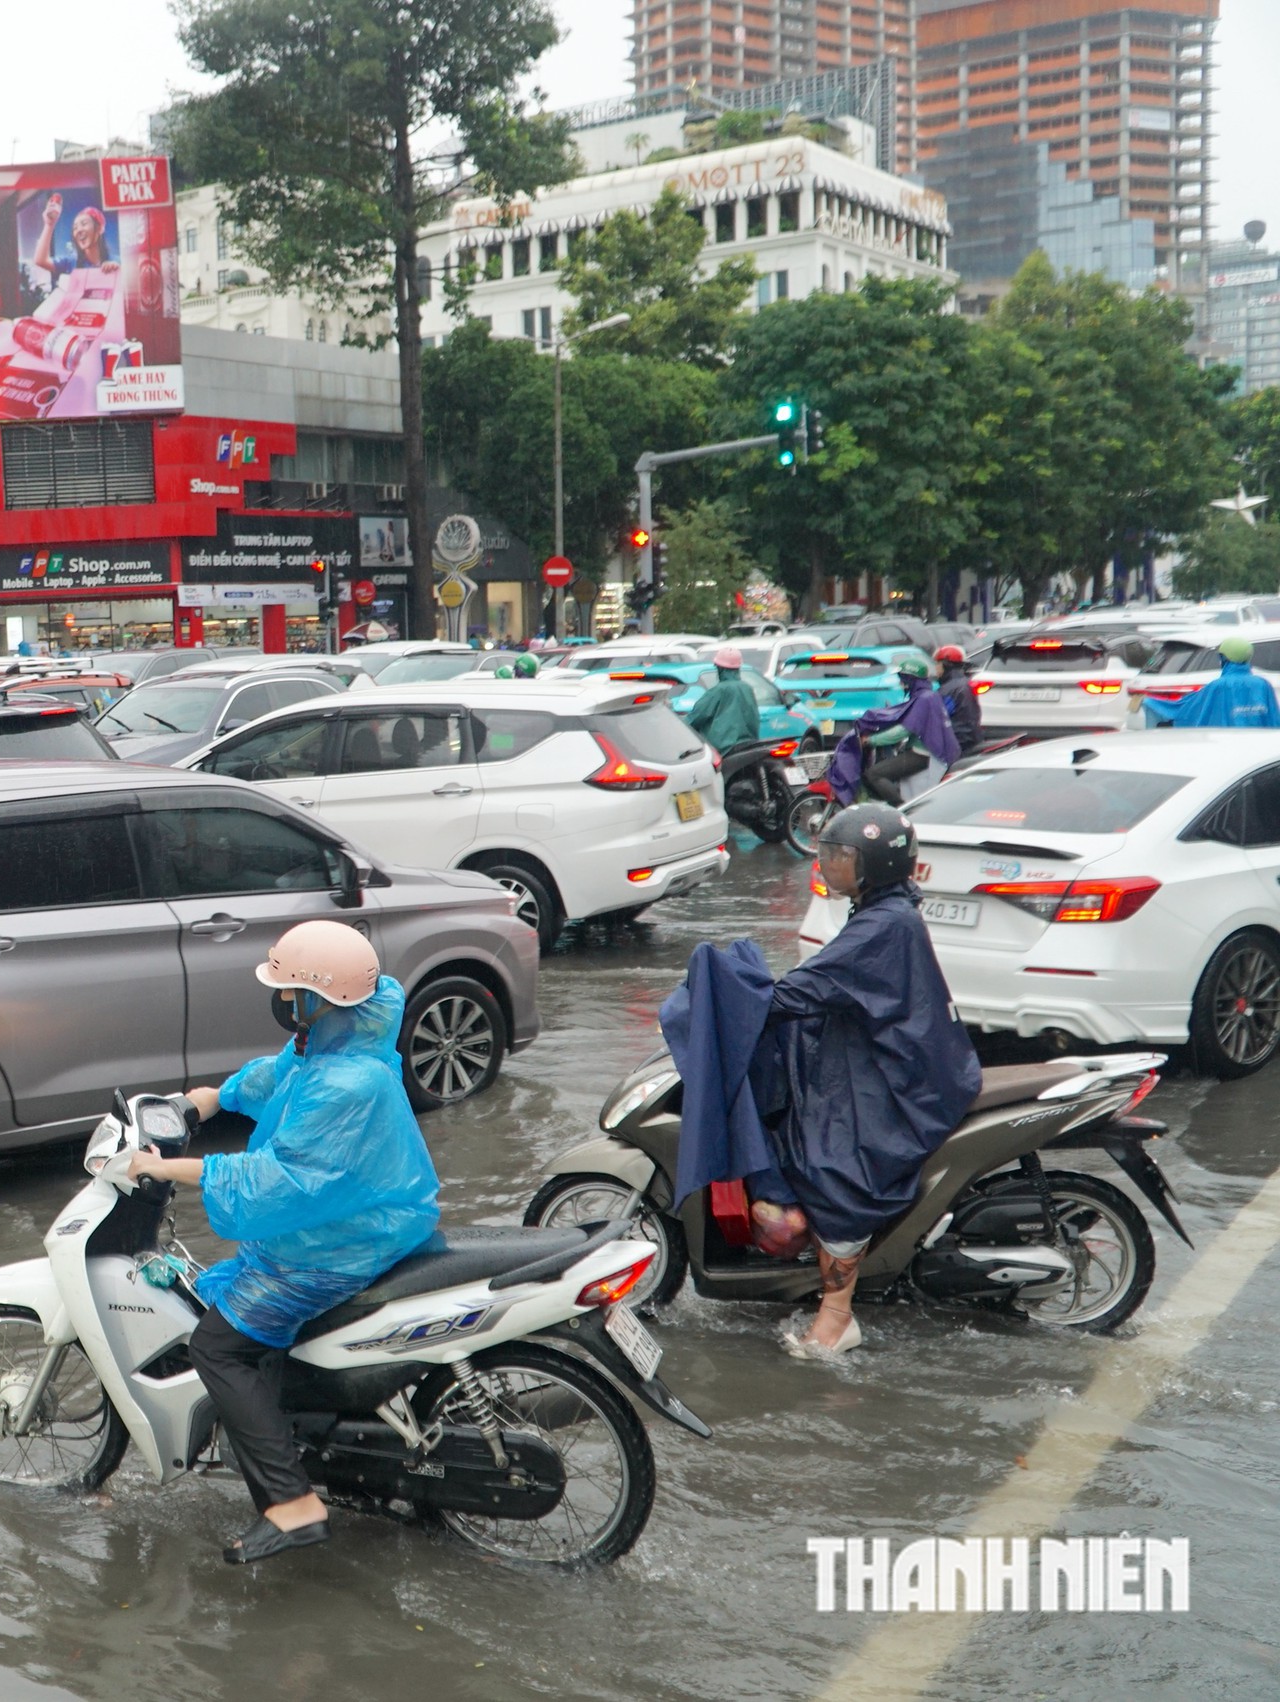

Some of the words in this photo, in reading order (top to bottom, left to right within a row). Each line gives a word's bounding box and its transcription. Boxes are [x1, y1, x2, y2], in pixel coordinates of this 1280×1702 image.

[111, 162, 156, 184] PARTY
[687, 158, 767, 191] MOTT
[775, 152, 805, 177] 23
[119, 181, 155, 202] PACK
[146, 371, 166, 385] HAY
[107, 390, 140, 404] TRONG
[234, 535, 262, 547] TRUNG
[263, 533, 281, 547] TÂM
[282, 535, 314, 547] LAPTOP
[69, 557, 151, 574] Shop.com.vn
[189, 549, 212, 566] ĐIỂM
[213, 551, 231, 566] ĐẾN
[232, 552, 257, 566] CÔNG
[258, 551, 281, 569] NGHỆ
[287, 554, 305, 566] CAM
[2, 577, 34, 589] Mobile
[43, 576, 73, 589] Laptop
[81, 574, 106, 587] Apple
[114, 571, 163, 585] Accessories
[1008, 1104, 1078, 1128] VISION
[108, 1303, 156, 1315] HONDA
